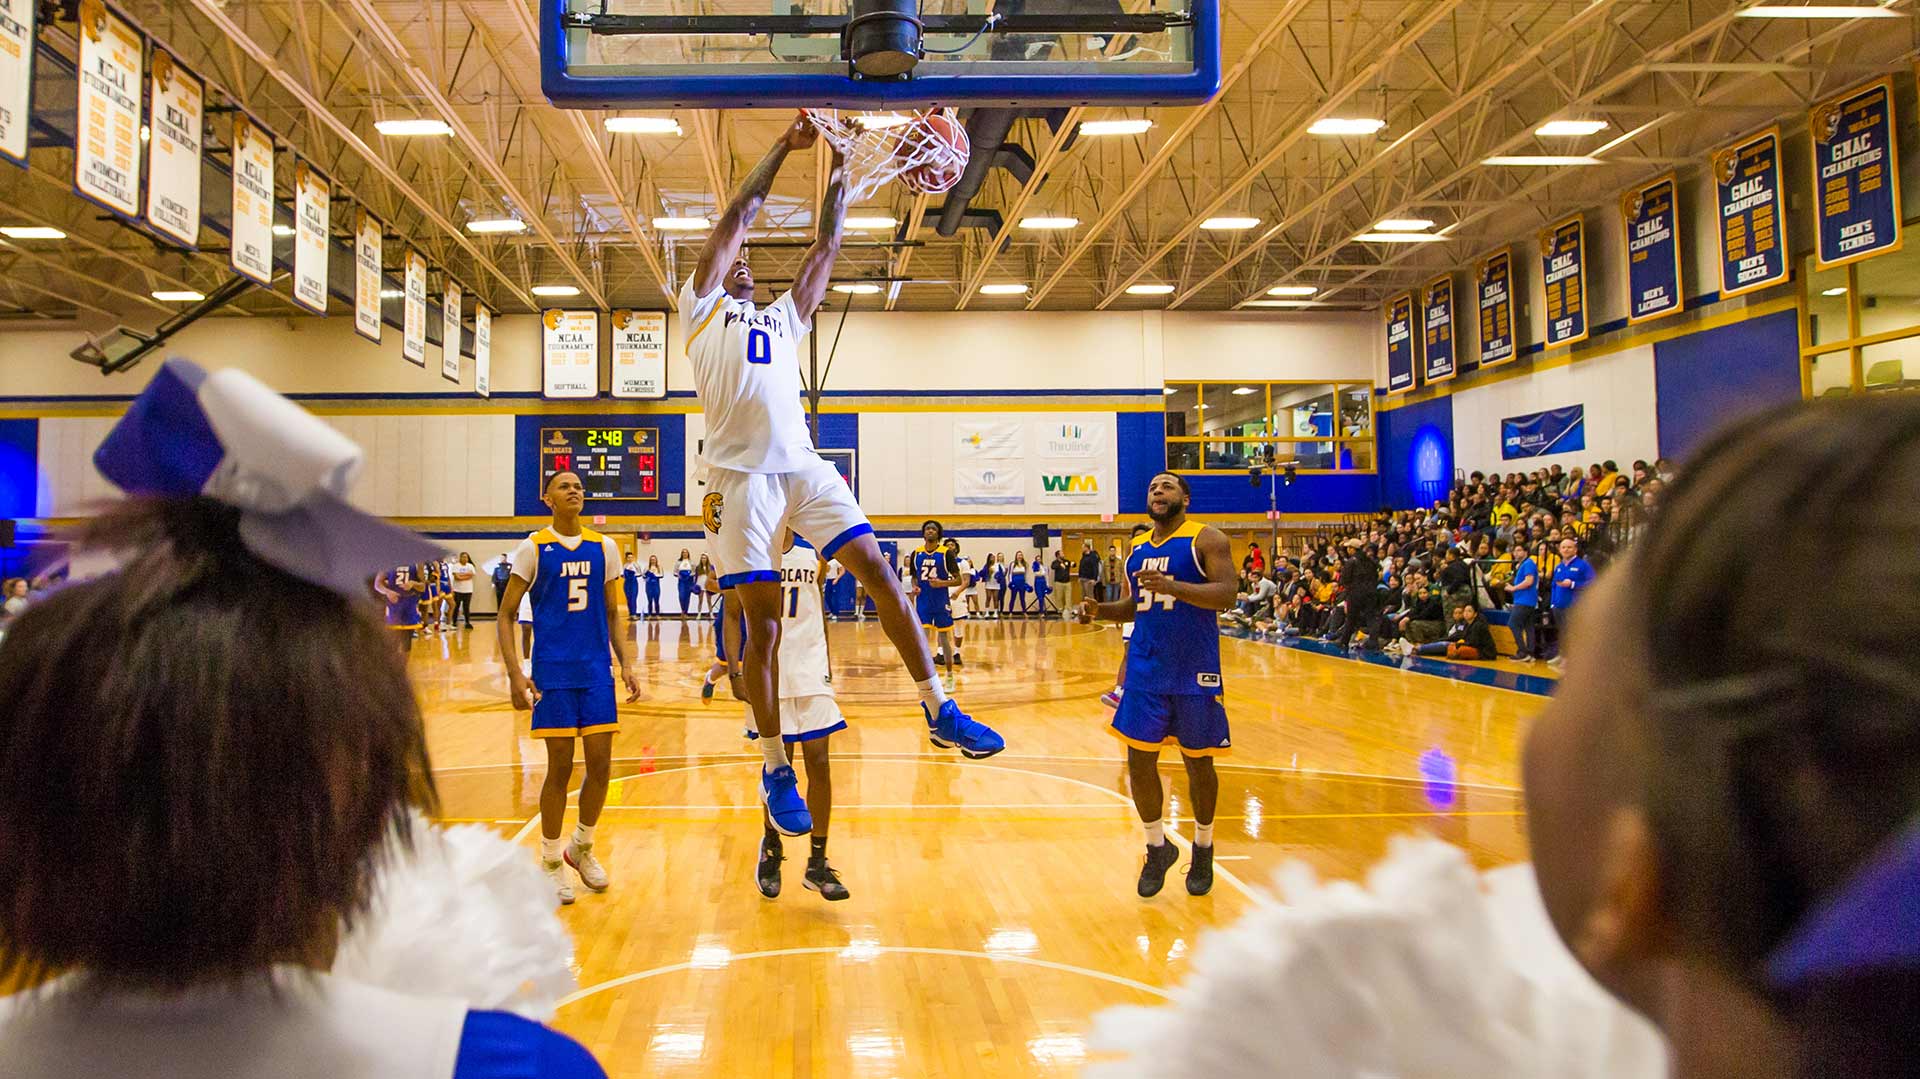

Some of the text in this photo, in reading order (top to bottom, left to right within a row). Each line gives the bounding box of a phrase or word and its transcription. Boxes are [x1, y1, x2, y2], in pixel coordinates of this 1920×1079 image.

[166, 104, 189, 134] NCAA
[1832, 131, 1872, 162] GNAC
[1822, 147, 1882, 178] CHAMPIONS
[1731, 175, 1764, 201] GNAC
[1724, 188, 1773, 217] CHAMPIONS
[1637, 215, 1663, 238] GNAC
[1841, 219, 1872, 239] MEN'S
[1630, 228, 1670, 252] CHAMPIONS
[1838, 231, 1876, 252] TENNIS
[1551, 252, 1573, 272] GNAC
[1739, 254, 1765, 271] MEN'S
[1737, 264, 1768, 284] SOCCER
[1643, 286, 1664, 301] MEN'S
[558, 334, 583, 342] NCAA
[626, 333, 652, 342] NCAA
[747, 328, 771, 364] 0
[587, 430, 622, 447] 2:48
[1048, 441, 1092, 452] Thruline
[555, 454, 570, 471] 14
[600, 455, 605, 470] 1
[639, 454, 655, 470] 14
[642, 476, 654, 493] 0
[1042, 475, 1099, 492] WM
[560, 561, 591, 577] JWU
[921, 567, 937, 580] 24
[568, 578, 588, 612] 5
